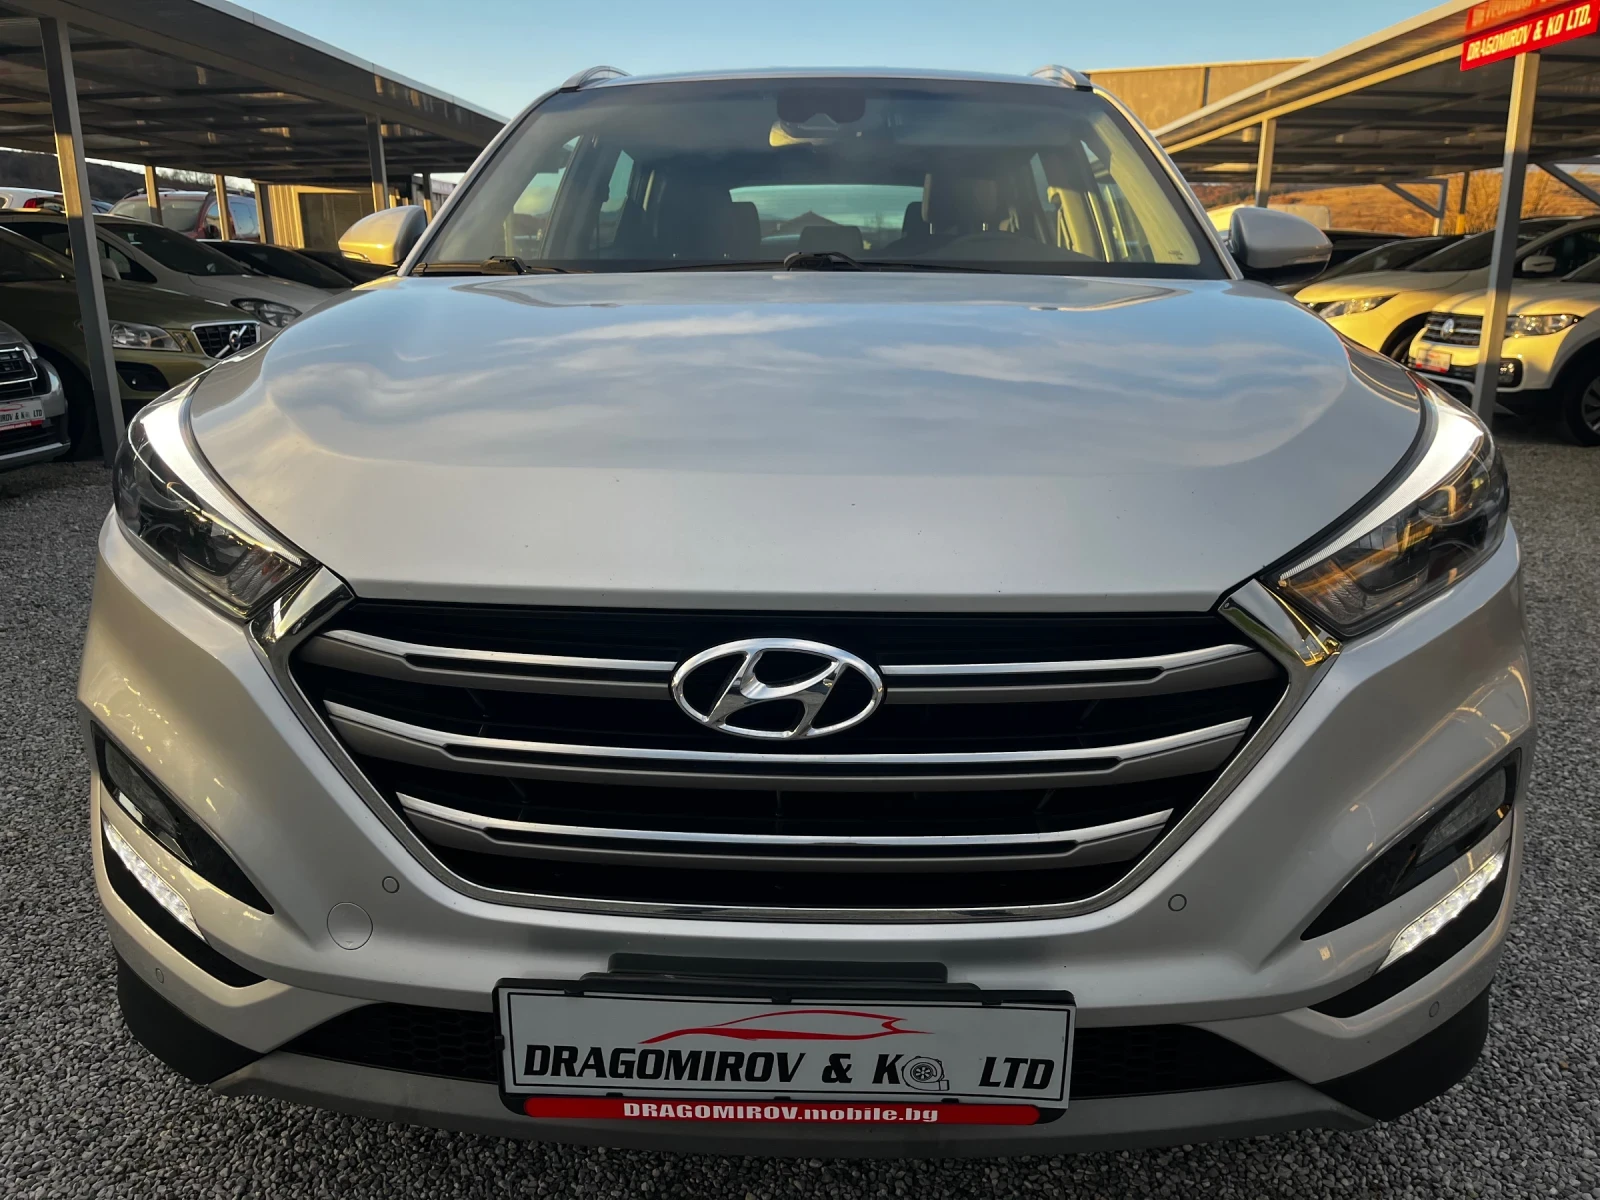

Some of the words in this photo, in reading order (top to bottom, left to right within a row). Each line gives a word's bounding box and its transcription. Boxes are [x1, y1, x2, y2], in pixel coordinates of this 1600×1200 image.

[1466, 24, 1532, 61] DRAGOMIROV
[1532, 20, 1543, 41] &
[1545, 13, 1564, 38] KO
[1566, 4, 1591, 31] LTD.
[523, 1044, 806, 1083] DRAGOMIROV
[821, 1053, 853, 1084] &
[978, 1056, 1055, 1090] LTD
[623, 1102, 939, 1123] DRAGOMIROV.mobile.bg
